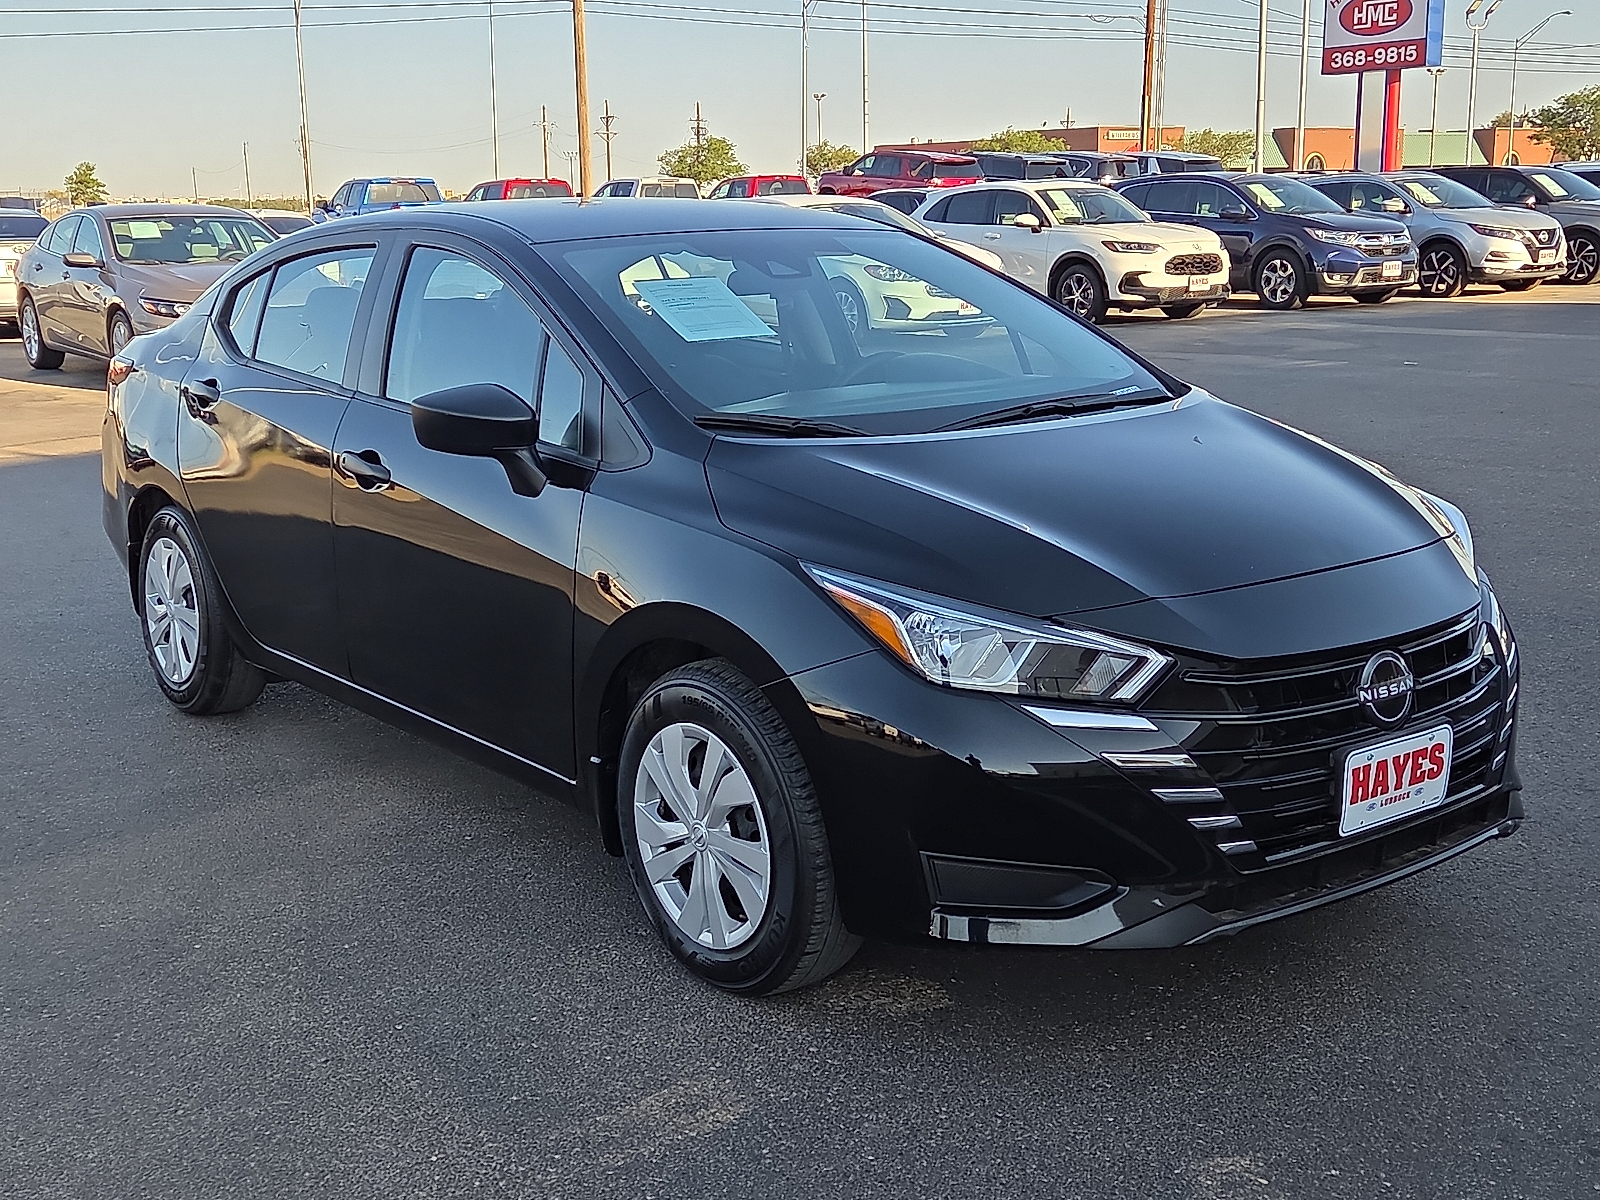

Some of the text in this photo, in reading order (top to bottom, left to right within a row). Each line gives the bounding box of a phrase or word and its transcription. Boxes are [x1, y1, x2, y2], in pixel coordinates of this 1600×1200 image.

[1352, 0, 1398, 29] HMC
[1330, 45, 1418, 69] 368-9815
[1359, 678, 1414, 703] NISSAN
[1349, 742, 1446, 806] HAYES
[1379, 790, 1412, 808] LUBBOCK
